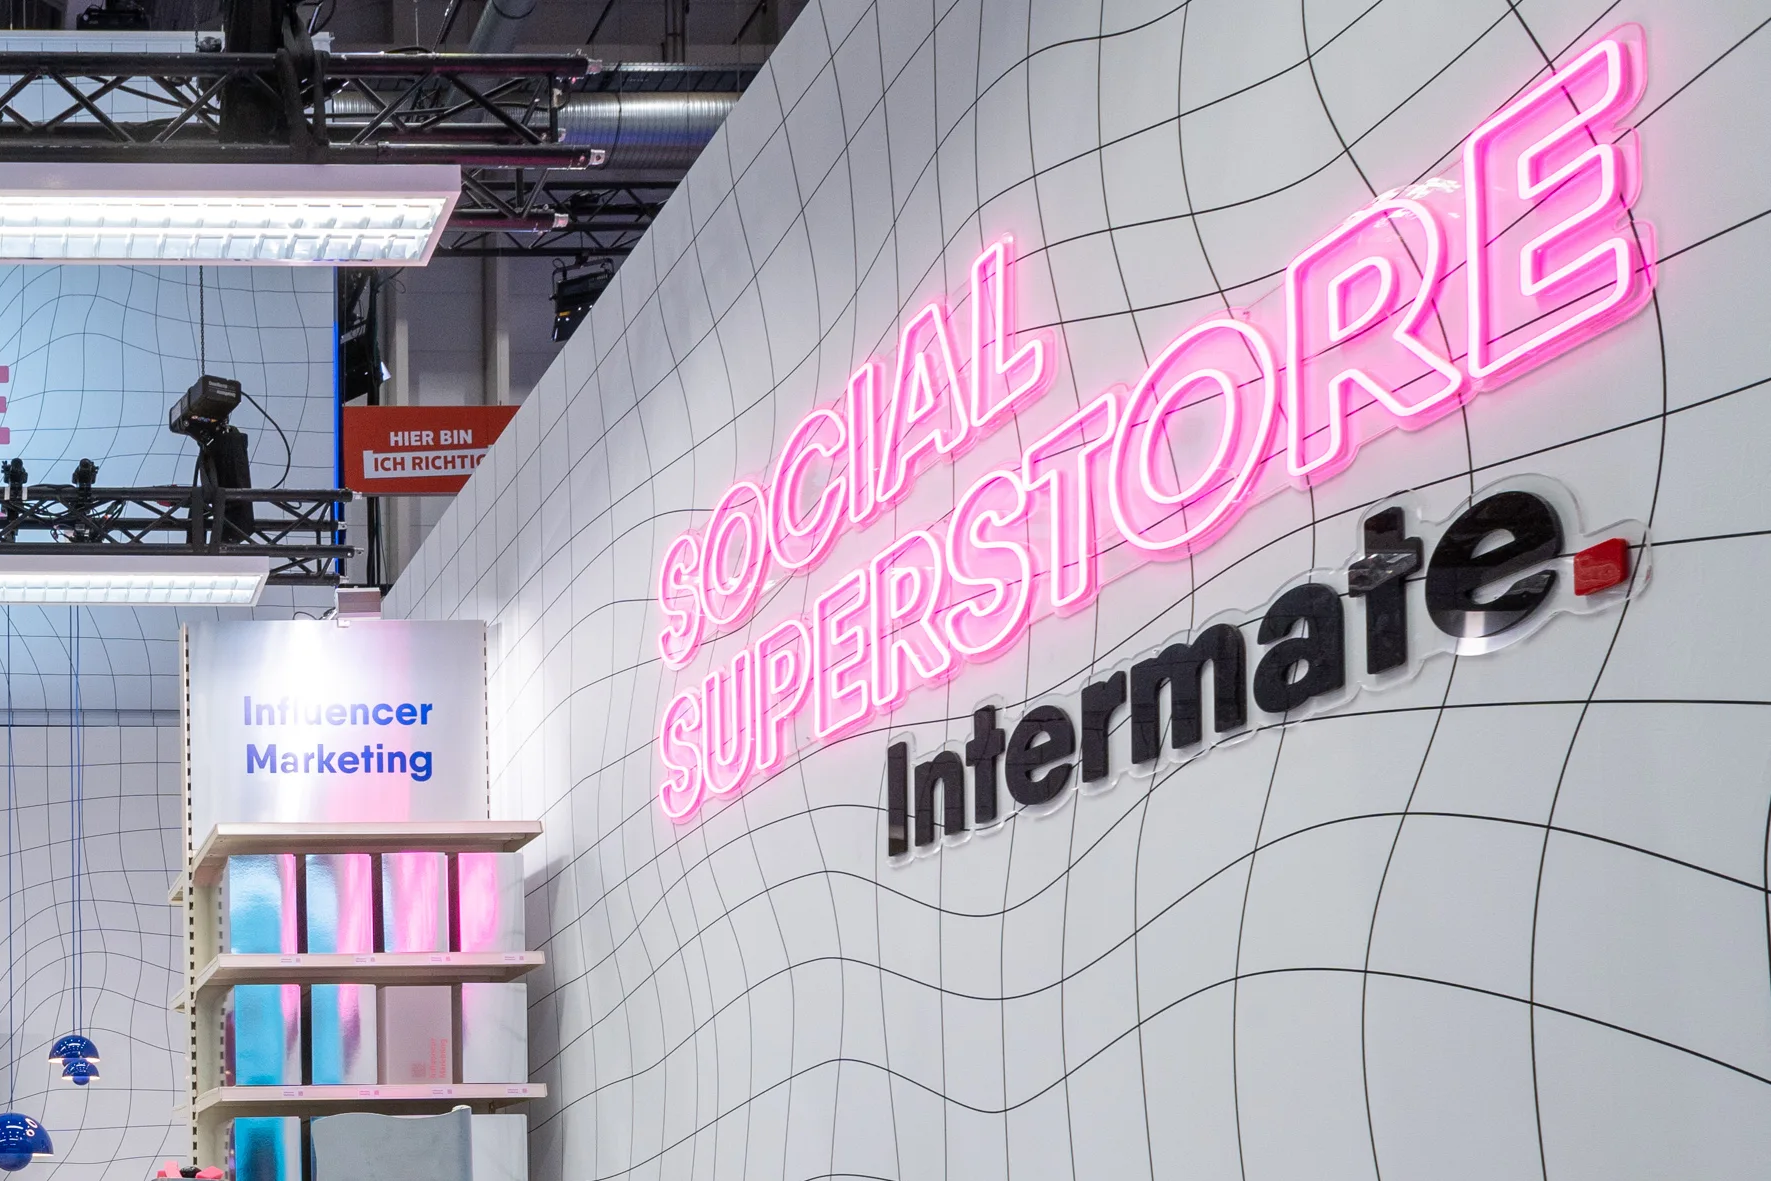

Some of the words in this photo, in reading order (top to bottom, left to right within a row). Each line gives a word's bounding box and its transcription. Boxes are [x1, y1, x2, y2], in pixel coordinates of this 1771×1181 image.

[389, 430, 434, 447] HIER
[440, 429, 473, 445] BIN
[660, 37, 1649, 821] SUPERSTORE
[374, 456, 405, 471] ICH
[658, 235, 1050, 665] SOCIAL
[888, 489, 1629, 858] Intermate.
[243, 695, 433, 727] Influencer
[246, 743, 433, 782] Marketing
